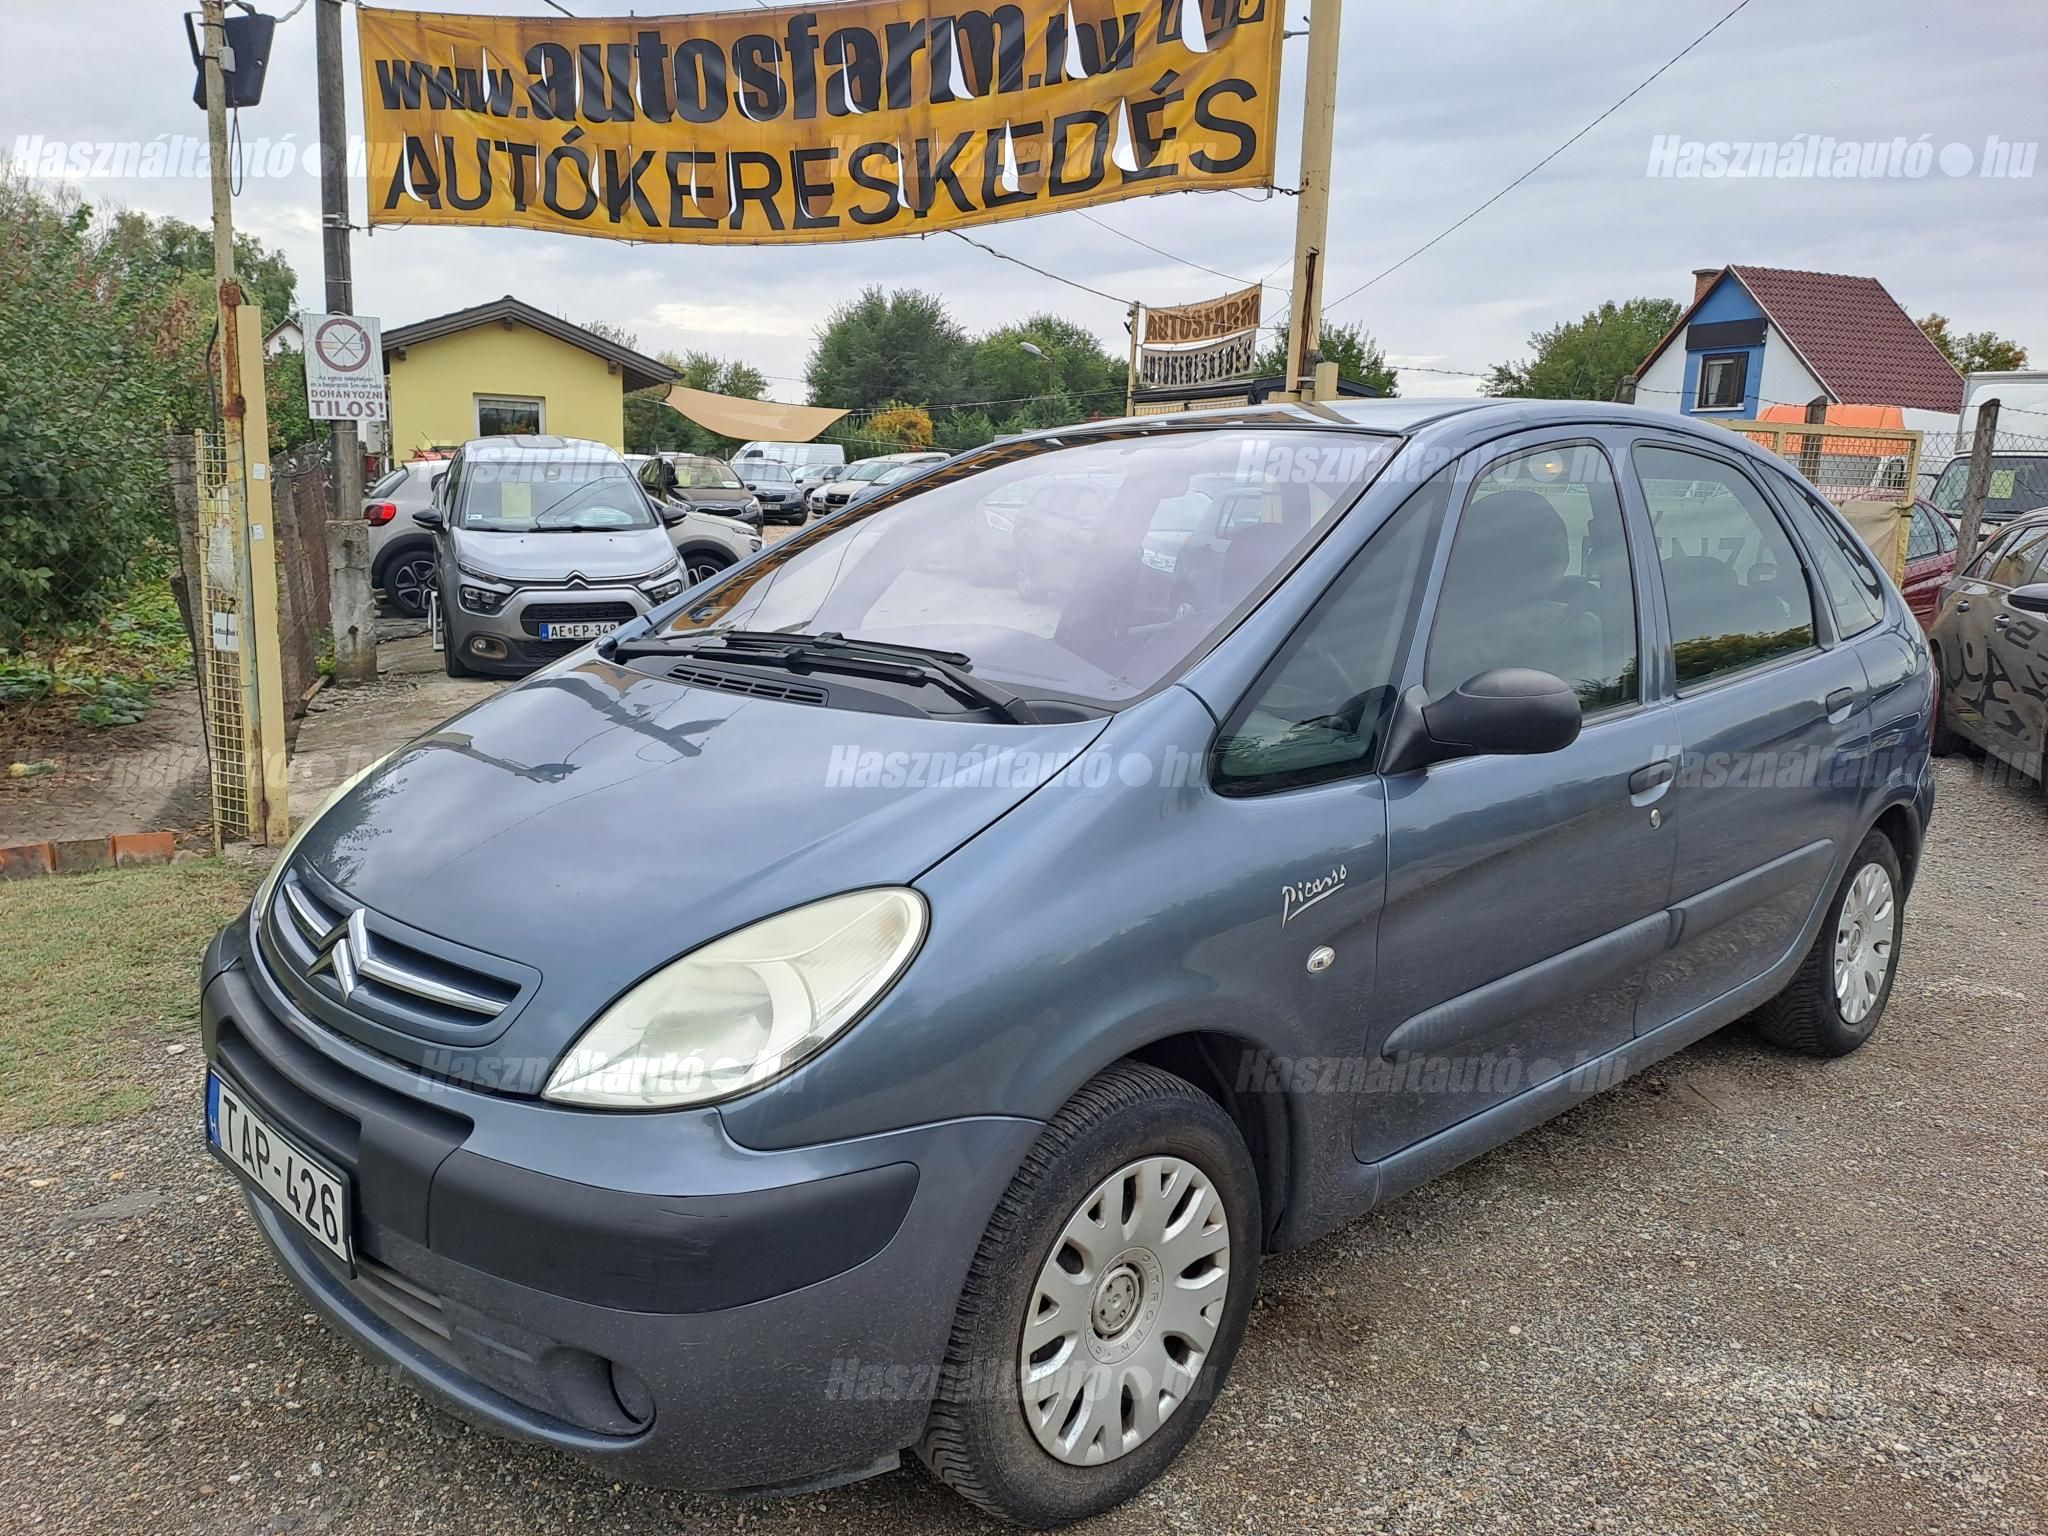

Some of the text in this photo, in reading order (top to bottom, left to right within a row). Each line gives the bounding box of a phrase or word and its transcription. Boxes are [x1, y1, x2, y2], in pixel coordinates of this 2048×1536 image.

[384, 69, 1258, 231] AUTÓKERESKEDÉS
[312, 400, 385, 418] TILOS!
[1281, 863, 1348, 930] Picasso
[223, 1094, 339, 1245] TAP-426
